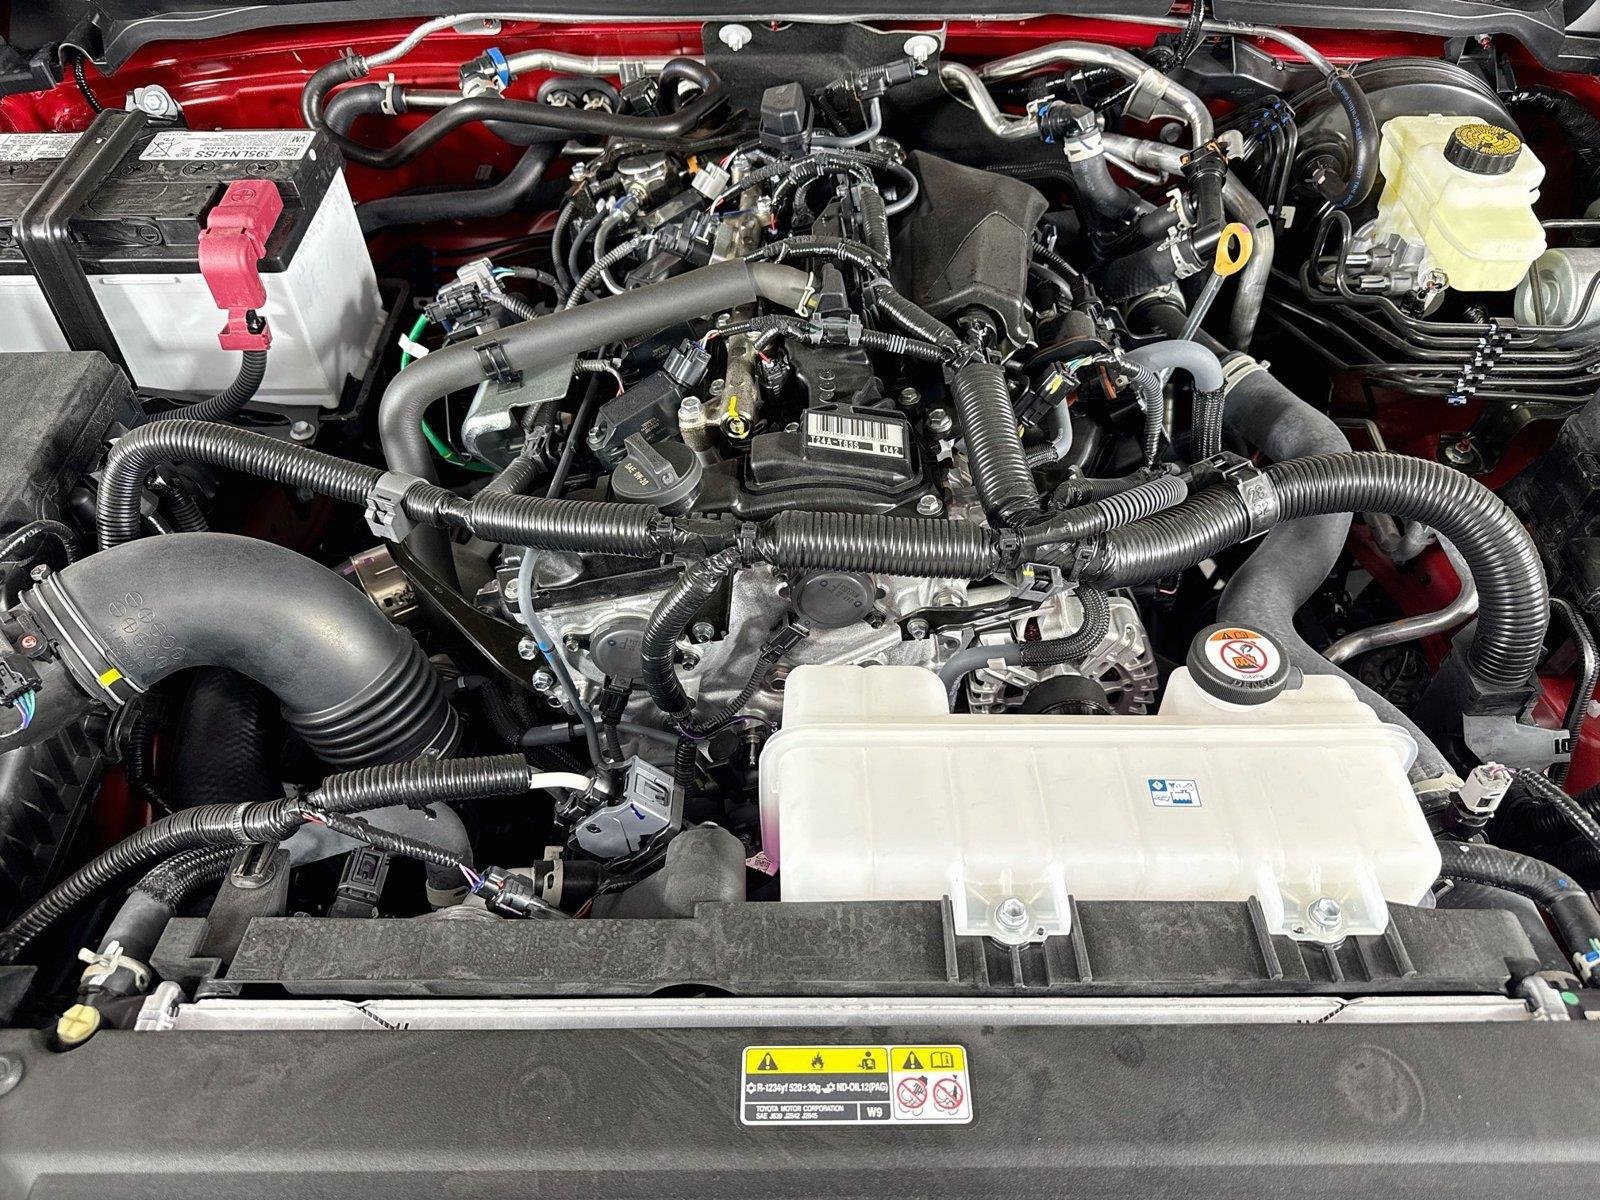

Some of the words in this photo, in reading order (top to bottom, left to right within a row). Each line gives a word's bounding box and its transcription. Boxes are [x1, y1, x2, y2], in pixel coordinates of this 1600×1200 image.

[194, 149, 274, 159] 395LN4-ISS
[802, 1104, 845, 1112] CORPORATION
[866, 1106, 883, 1118] W9
[755, 1112, 769, 1120] SAE
